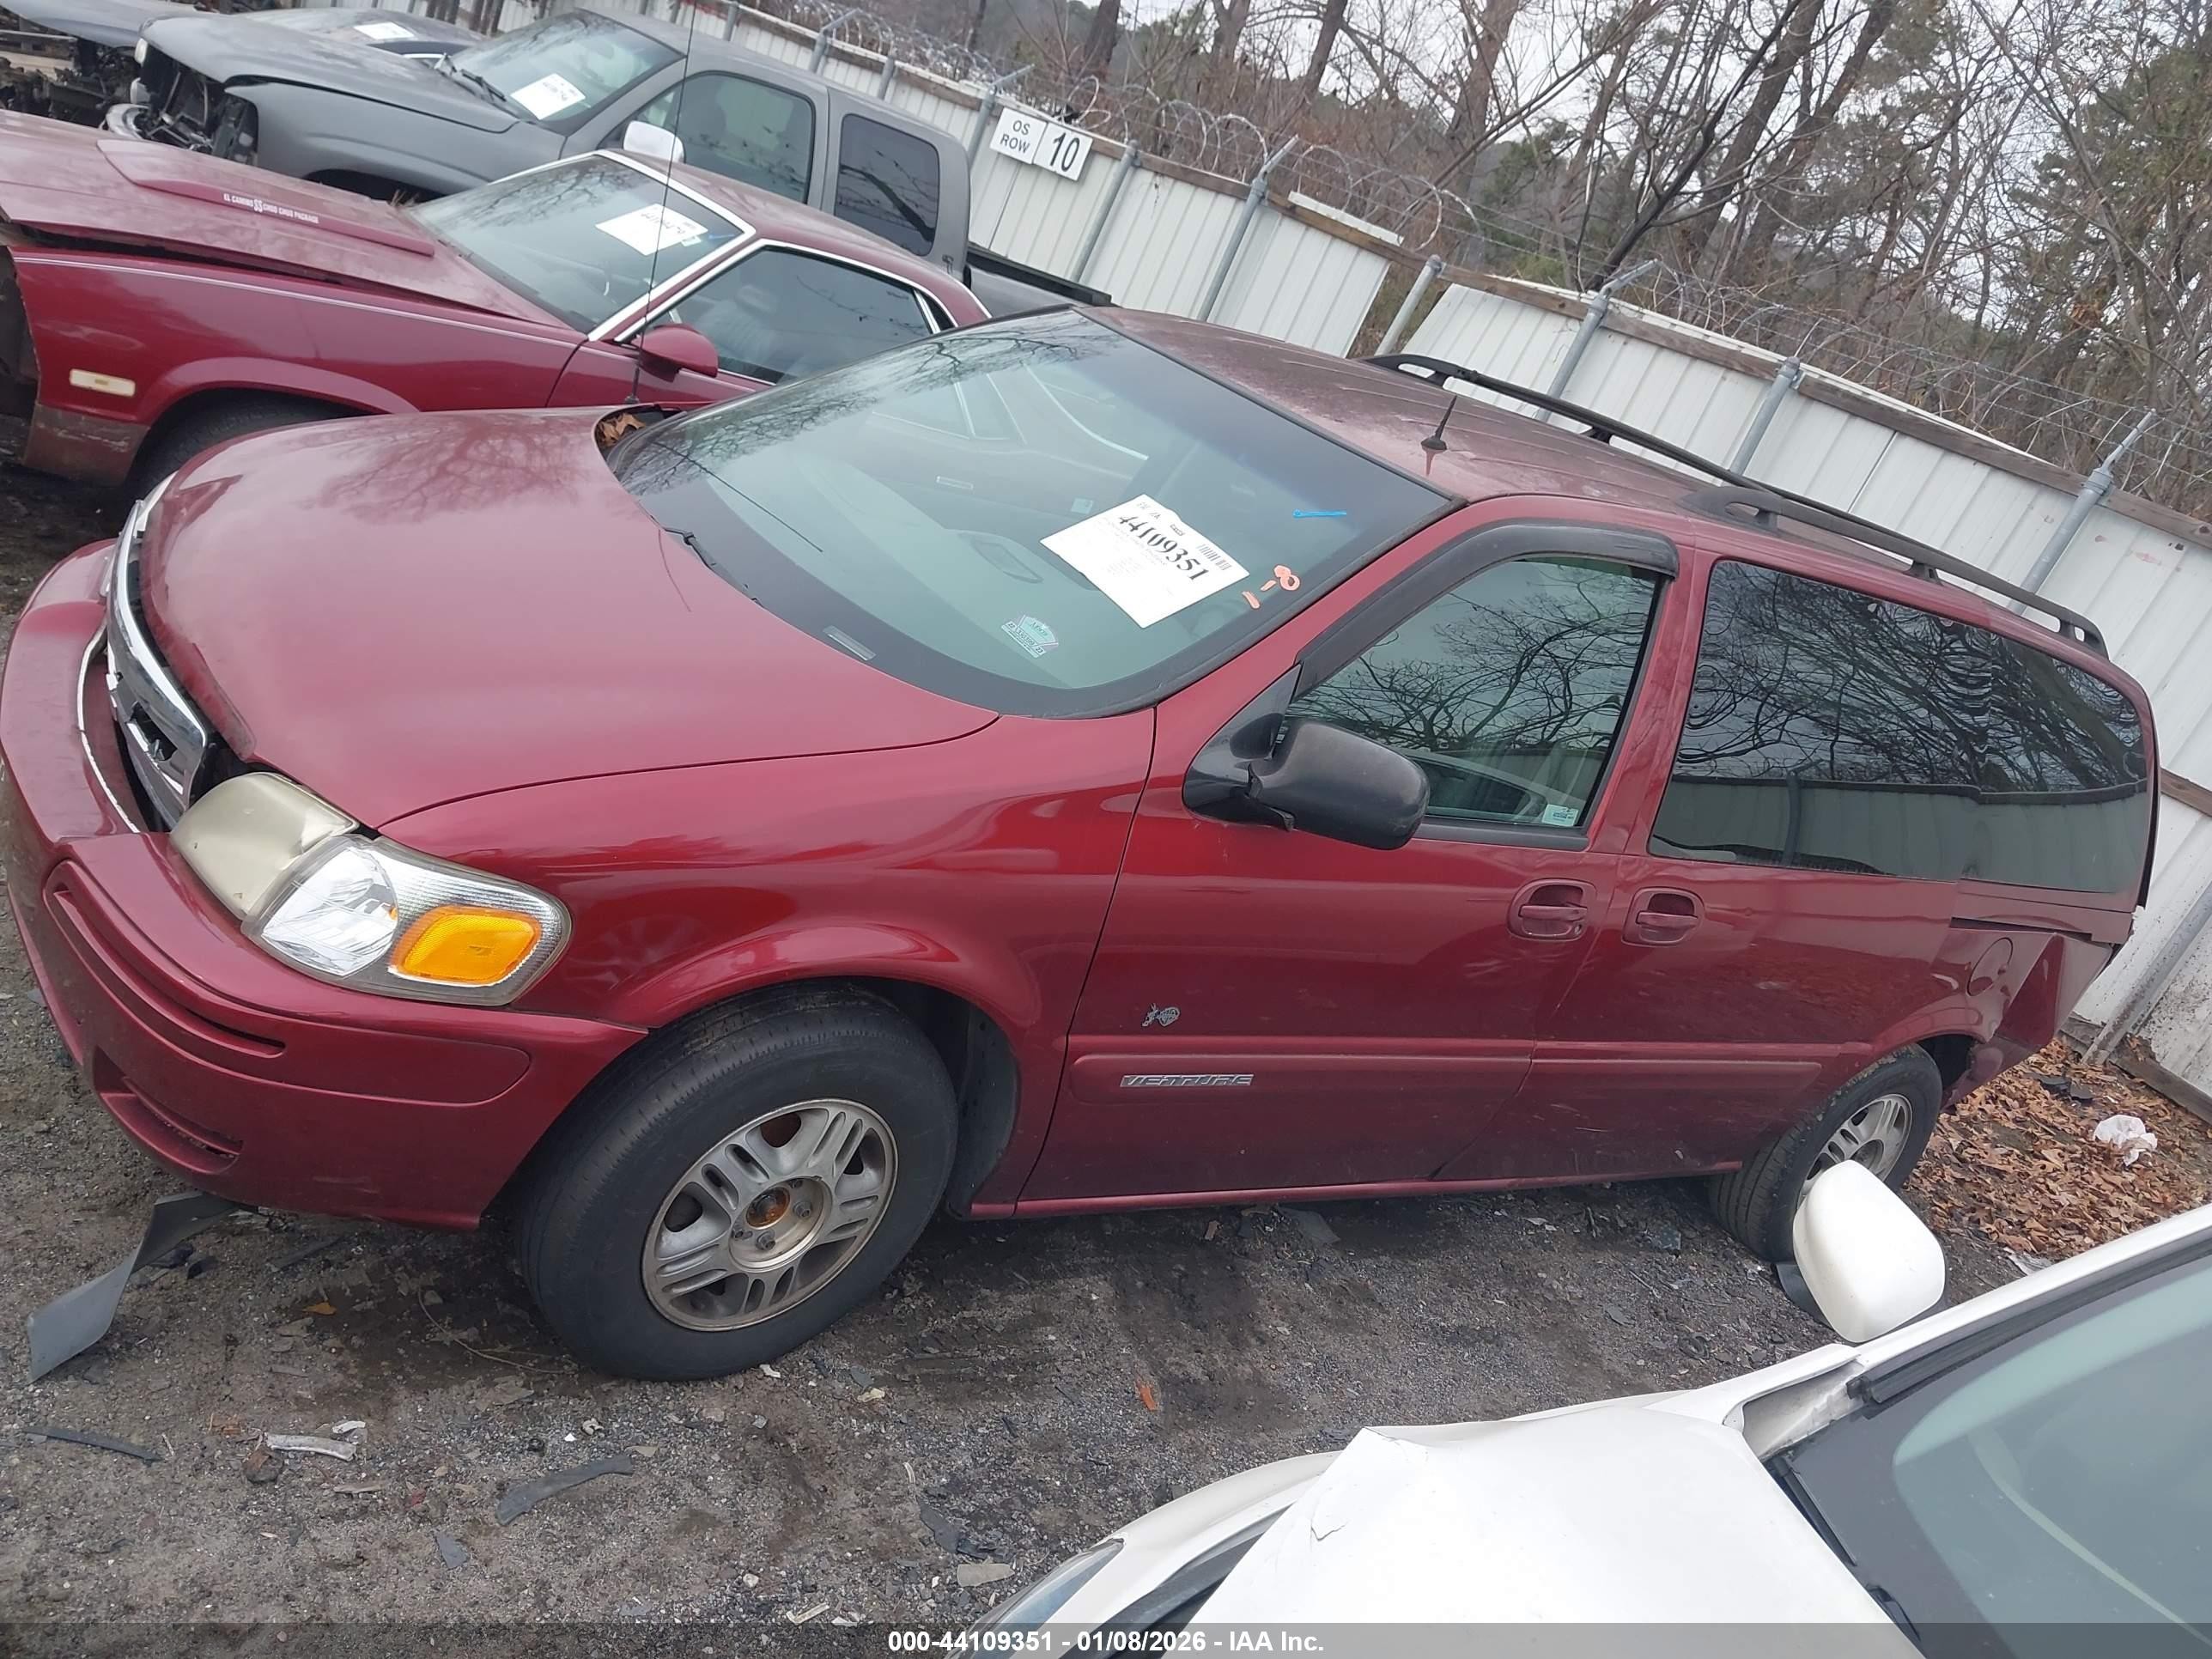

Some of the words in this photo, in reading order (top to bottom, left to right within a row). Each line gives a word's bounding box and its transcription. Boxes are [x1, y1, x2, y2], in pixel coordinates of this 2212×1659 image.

[1012, 119, 1030, 136] OS
[1000, 133, 1030, 154] ROW
[1049, 132, 1080, 172] 10
[1119, 514, 1210, 580] 44109351
[1119, 1073, 1255, 1088] VENTURE
